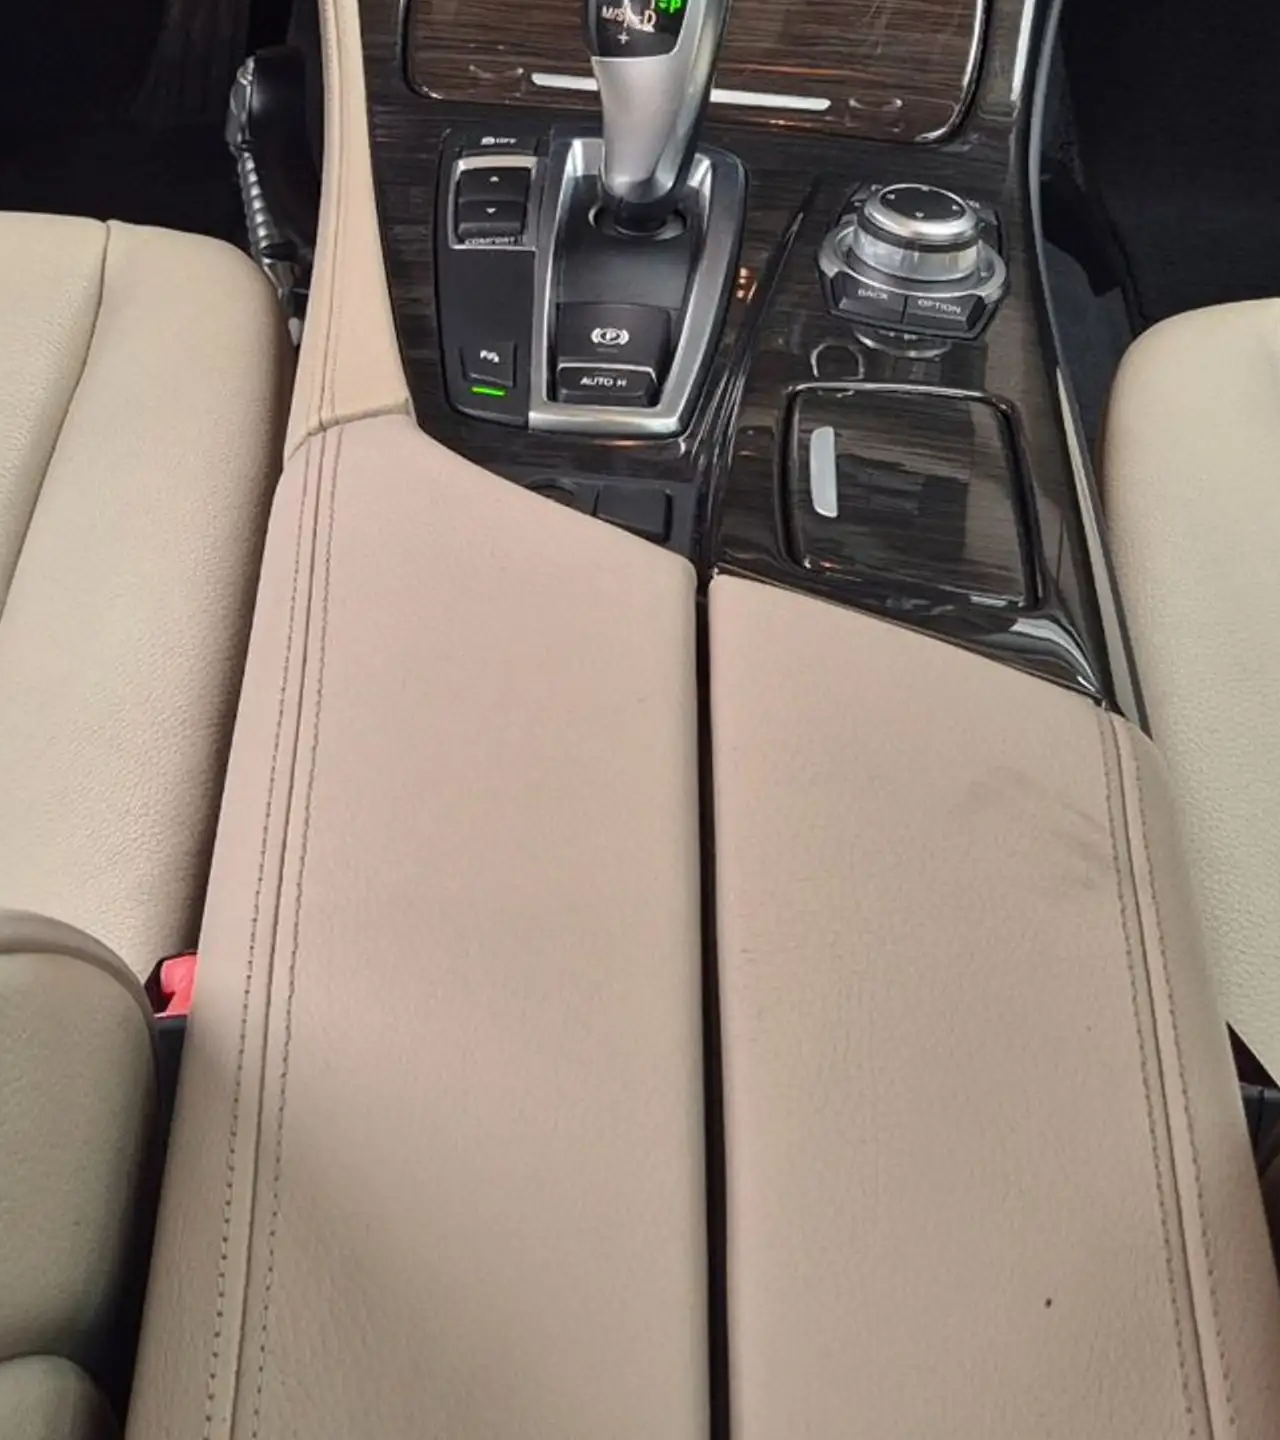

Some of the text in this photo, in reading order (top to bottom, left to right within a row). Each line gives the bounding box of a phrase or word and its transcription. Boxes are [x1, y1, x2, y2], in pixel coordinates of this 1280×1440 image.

[643, 11, 657, 27] D
[857, 288, 889, 300] BACK
[917, 297, 962, 314] OPTION
[579, 375, 613, 387] AUTO
